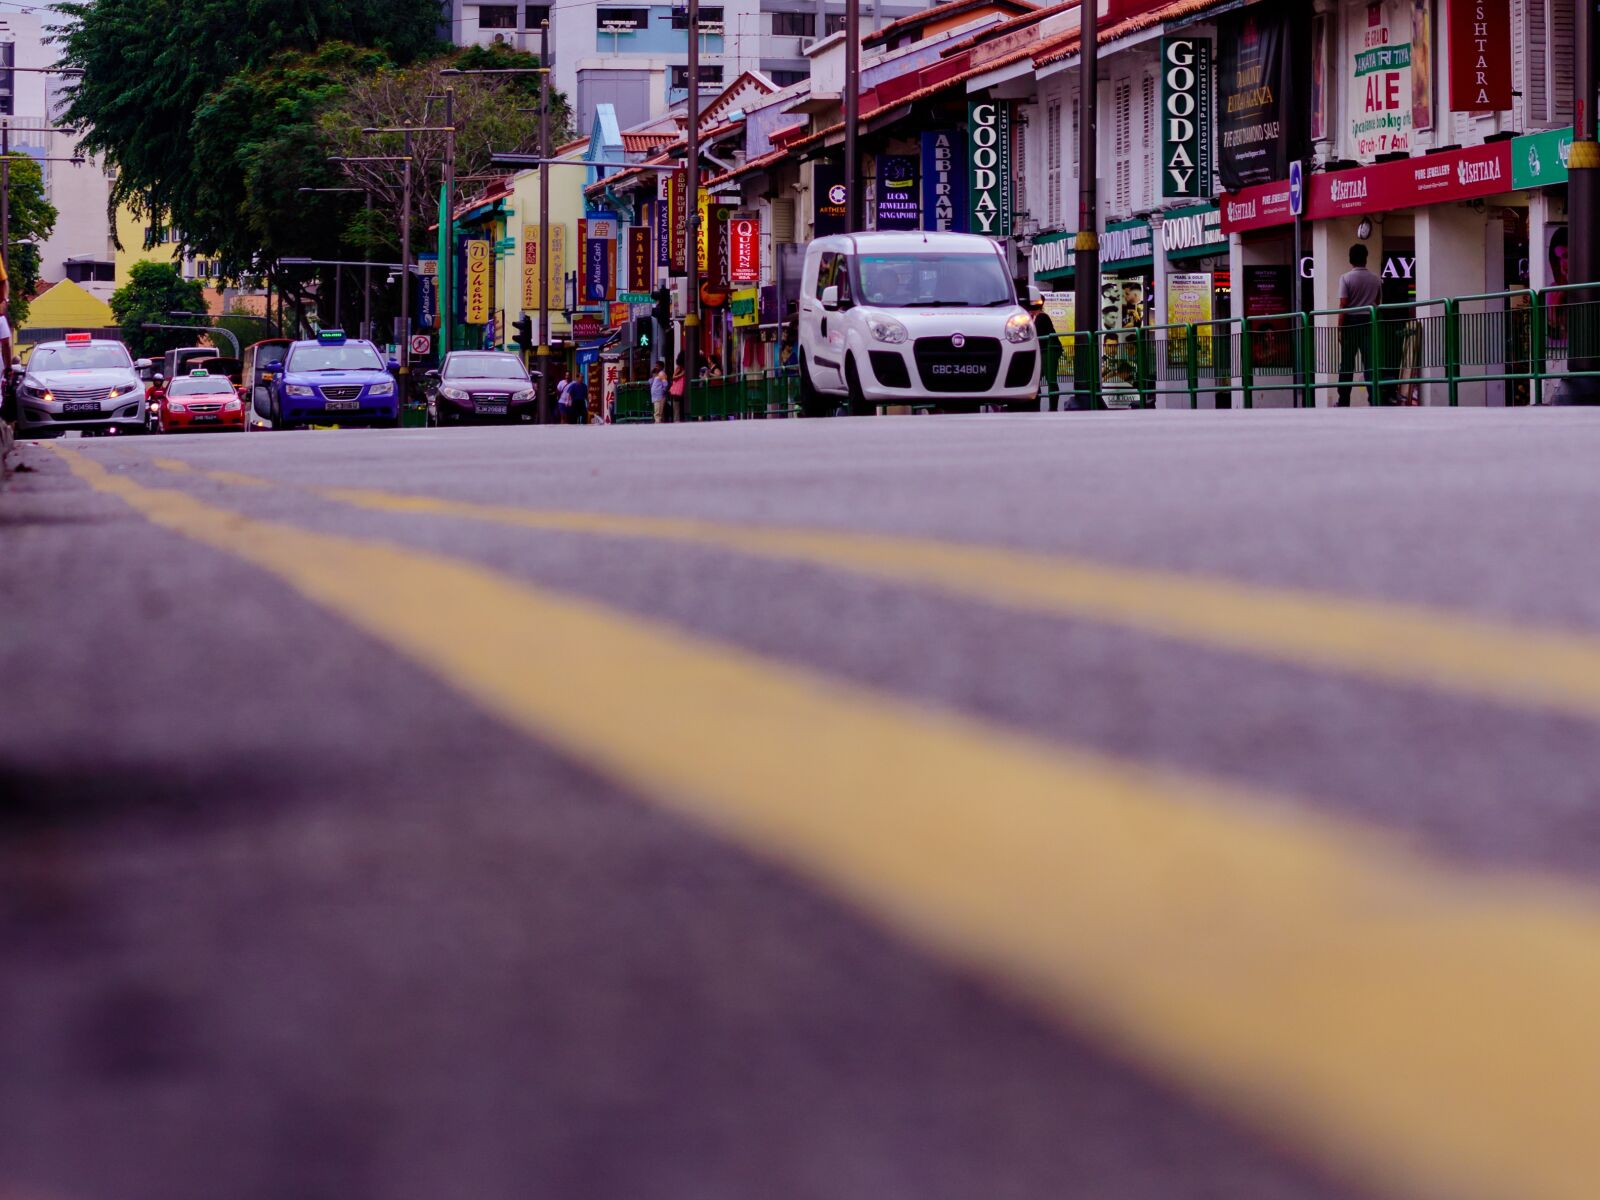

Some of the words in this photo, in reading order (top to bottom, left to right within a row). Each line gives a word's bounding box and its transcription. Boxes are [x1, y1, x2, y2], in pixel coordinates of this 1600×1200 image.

[1200, 47, 1208, 71] Care
[1200, 73, 1208, 118] Personal
[1001, 109, 1009, 129] Care
[1166, 40, 1195, 193] GOODAY
[1001, 130, 1009, 169] Personal
[1200, 120, 1208, 151] About
[972, 104, 998, 232] GOODAY
[1200, 152, 1208, 168] All
[1465, 155, 1501, 185] ISHTARA
[1001, 174, 1009, 197] About
[1200, 170, 1208, 187] It's
[1337, 175, 1368, 201] ISHTARA
[879, 202, 918, 210] JEWELLERY
[886, 192, 909, 200] LUCKY
[1232, 197, 1257, 222] ISHTARA
[879, 211, 918, 219] SINGAPORE
[1161, 213, 1205, 251] GOODAY
[472, 246, 485, 257] 71
[593, 243, 602, 284] Maxi-Cash
[635, 231, 644, 287] SATYA
[718, 224, 729, 286] KAMALA
[1031, 240, 1068, 273] GOODAY
[422, 276, 430, 314] Maxi-Cash
[471, 261, 486, 320] Chennai
